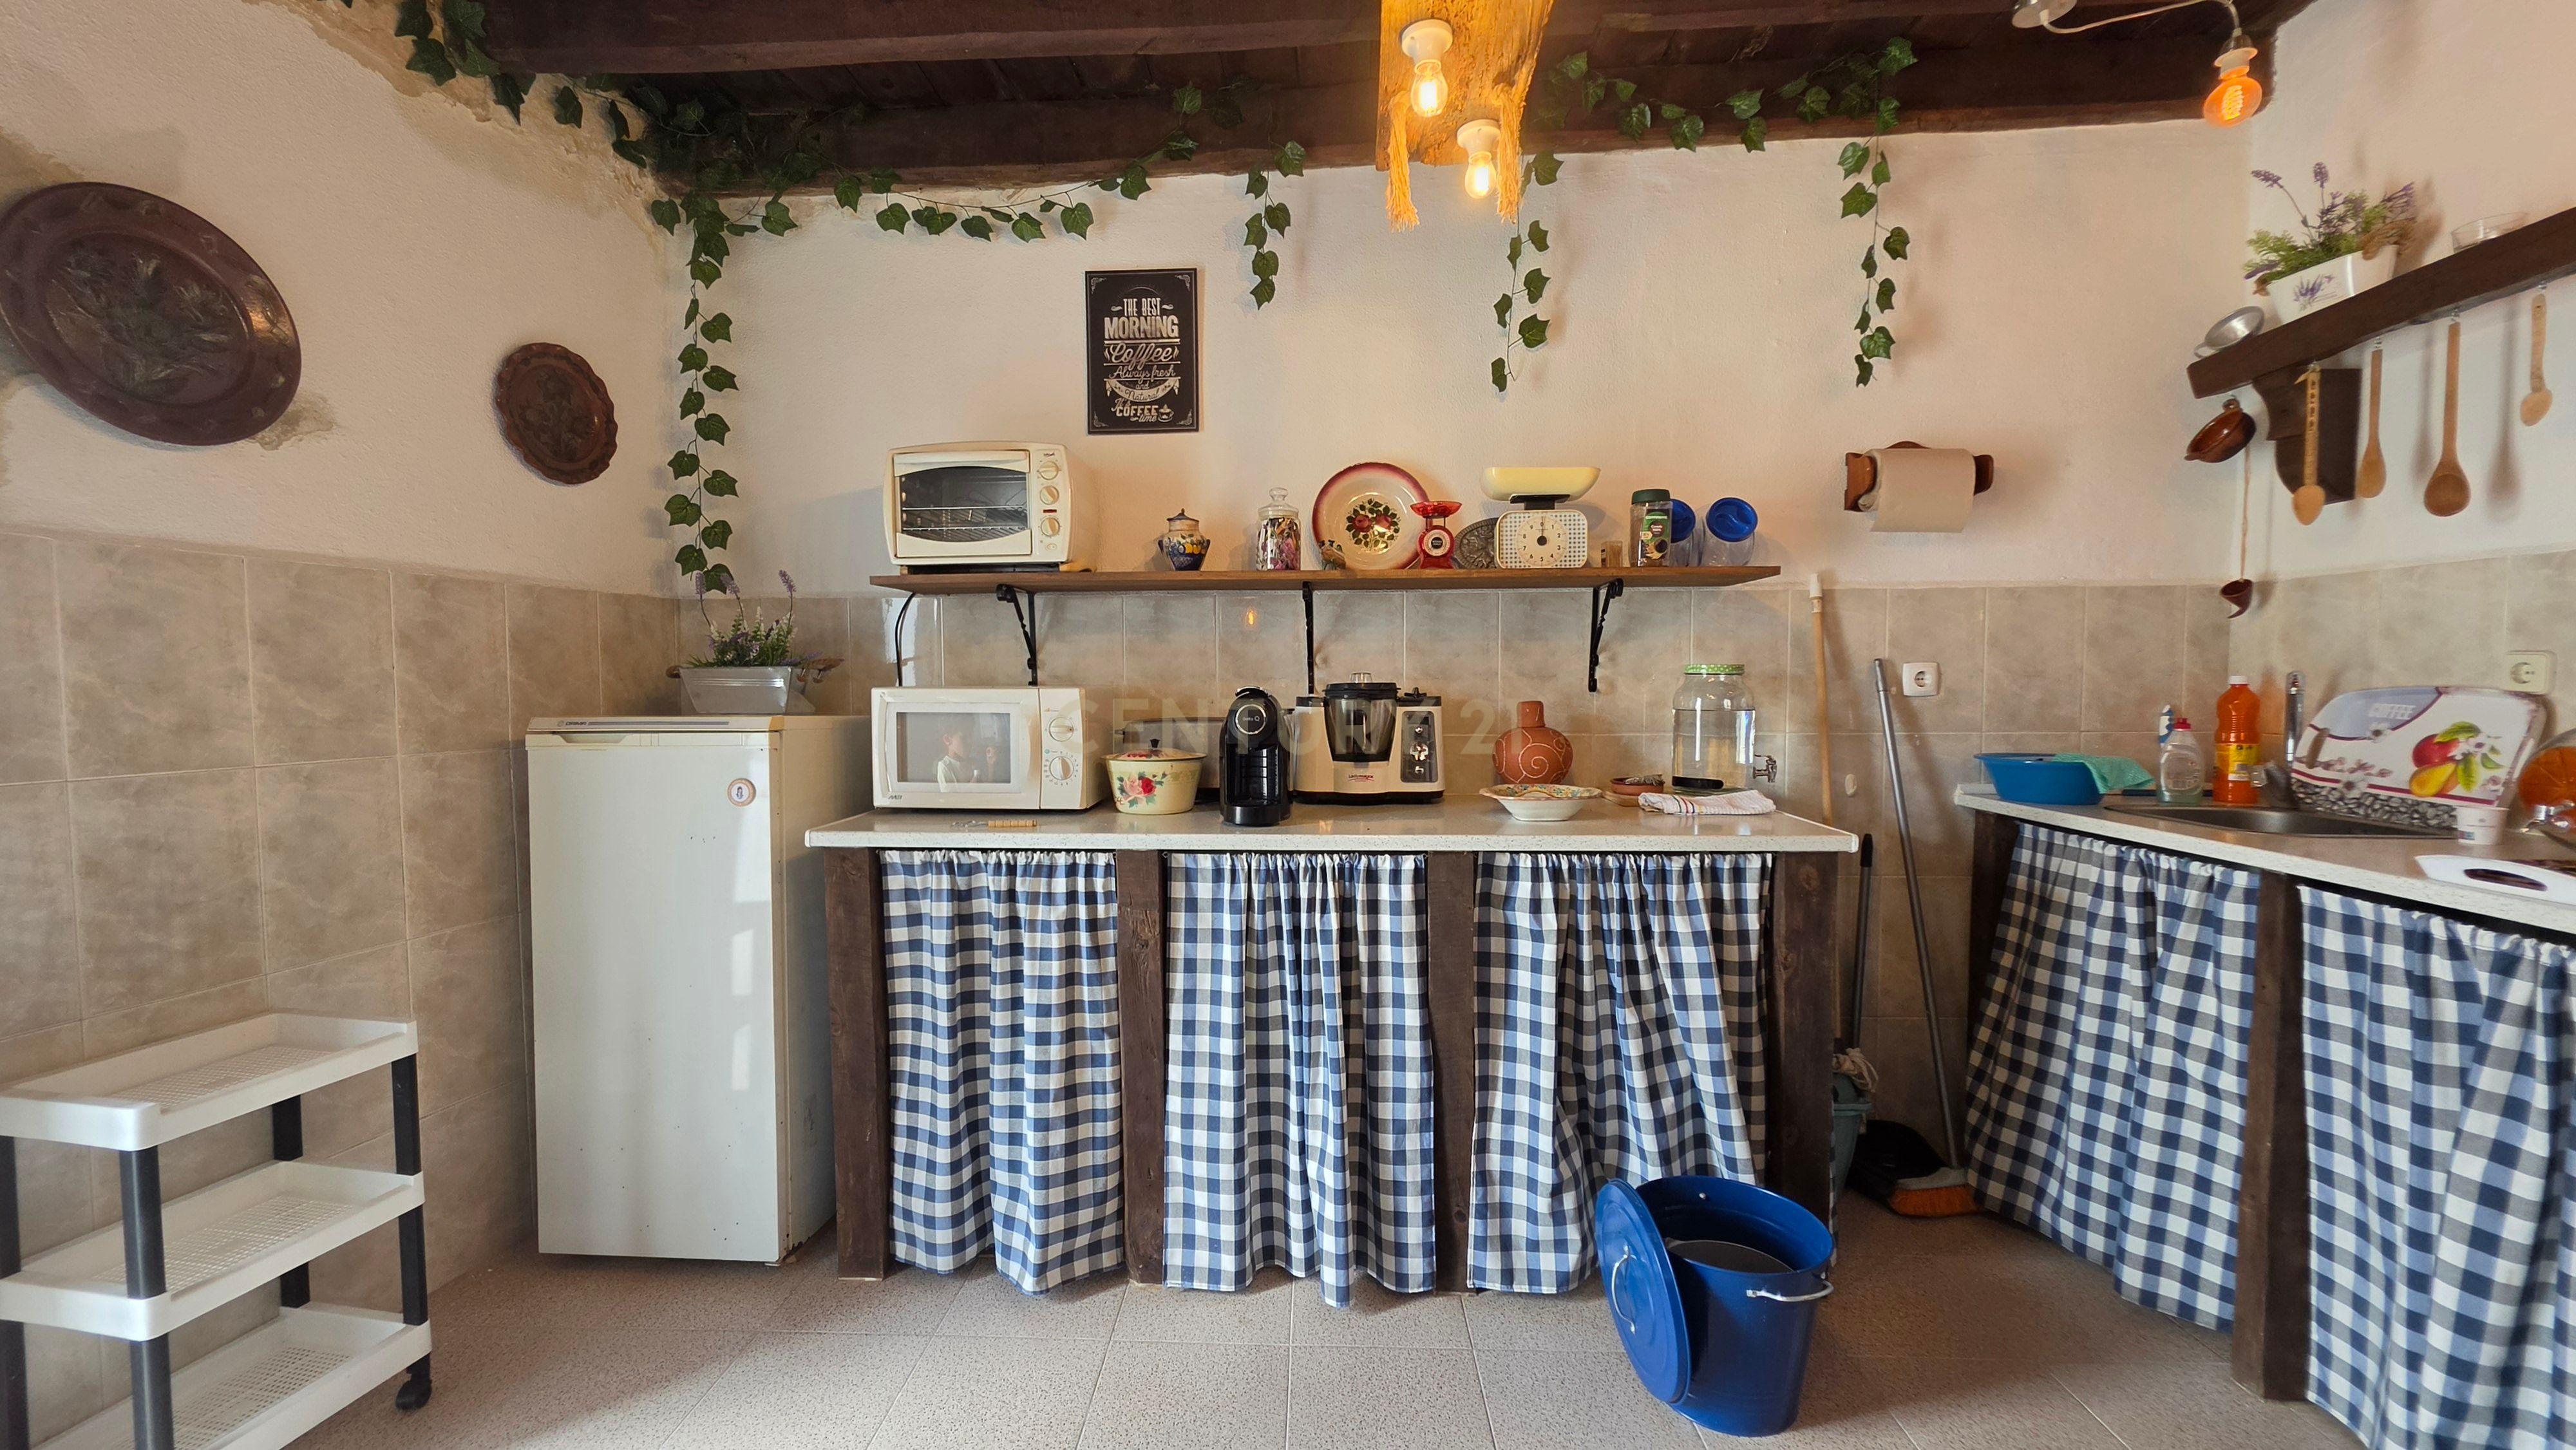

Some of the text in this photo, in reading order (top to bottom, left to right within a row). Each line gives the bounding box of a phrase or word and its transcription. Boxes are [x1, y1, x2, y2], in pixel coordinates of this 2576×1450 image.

[1123, 297, 1160, 316] THE BEST
[1104, 315, 1179, 339] MORNING
[1110, 342, 1173, 370] Coffee
[1109, 364, 1176, 384] Always fresh
[1135, 381, 1149, 390] and
[1125, 388, 1160, 400] Natural
[1111, 397, 1131, 411] It's
[1115, 405, 1159, 417] COFFEE
[1138, 414, 1157, 422] time
